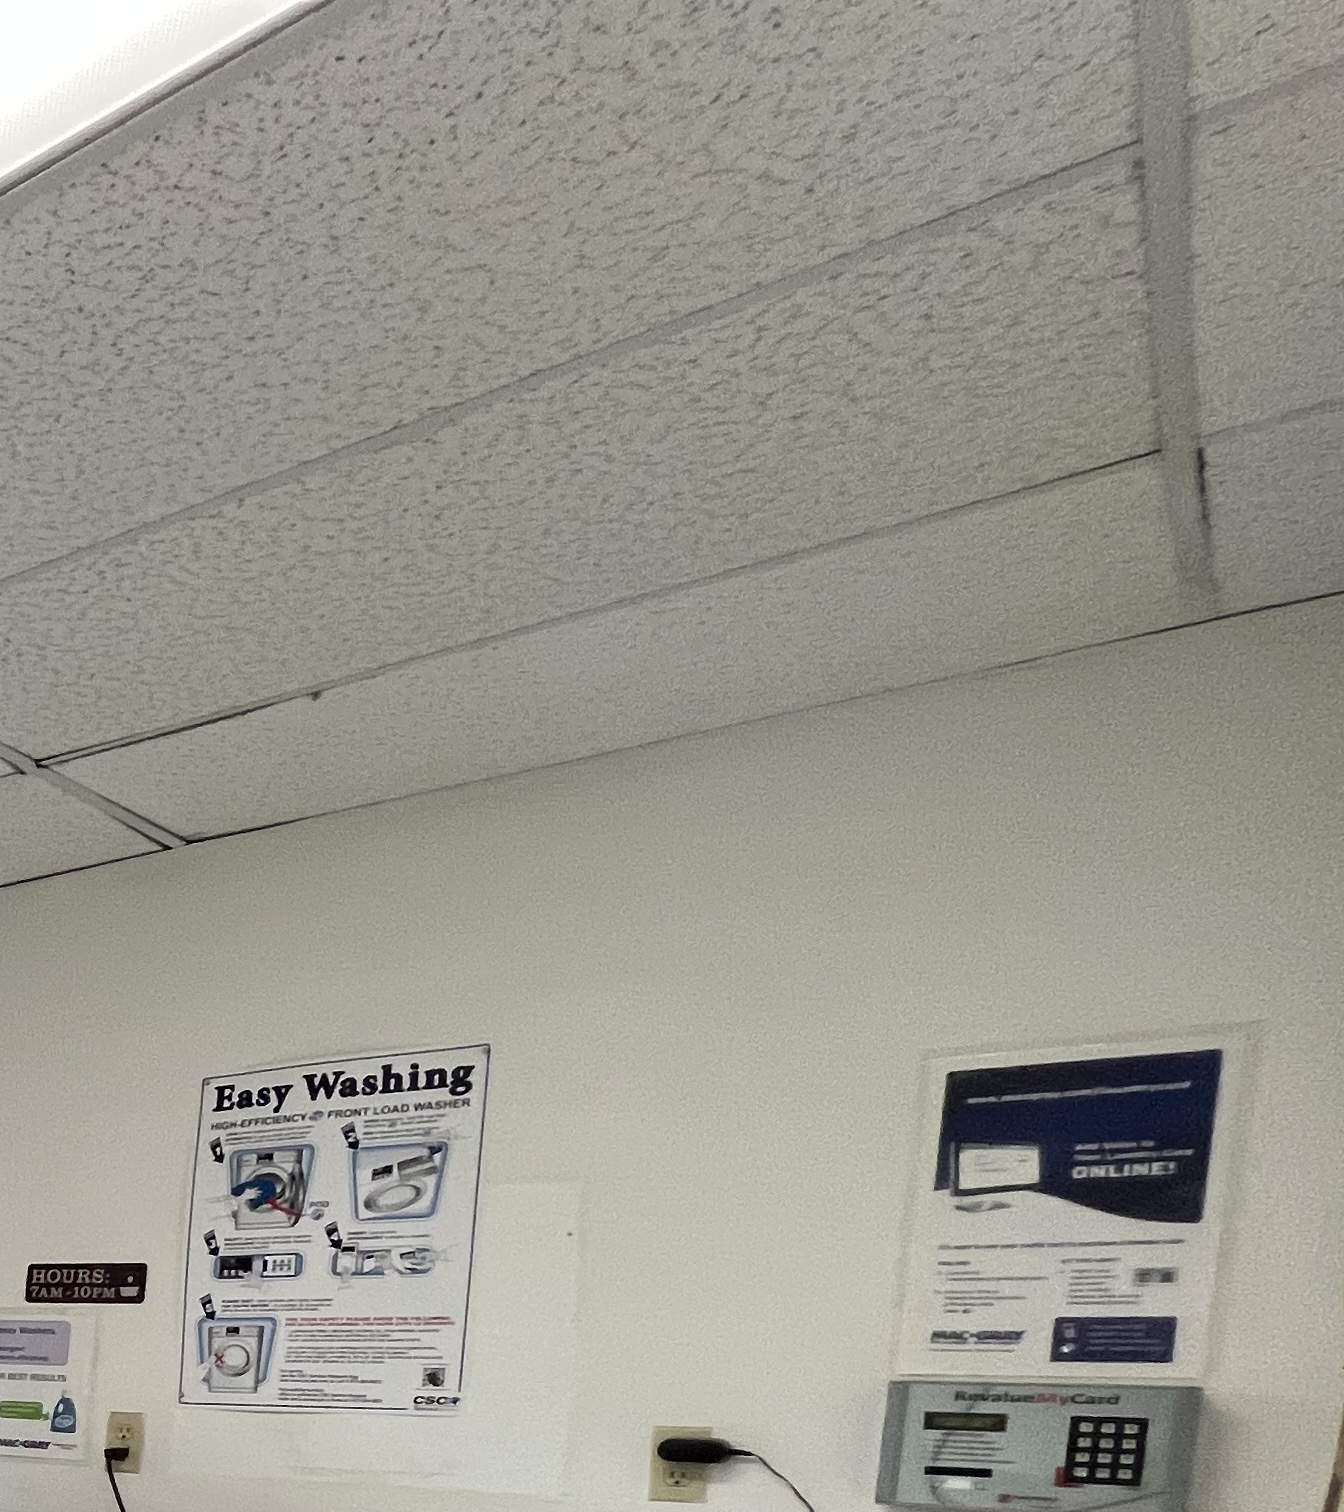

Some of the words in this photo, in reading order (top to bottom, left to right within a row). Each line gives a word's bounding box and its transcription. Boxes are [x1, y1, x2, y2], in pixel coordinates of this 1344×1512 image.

[212, 1084, 294, 1113] Easy
[303, 1063, 475, 1097] Washing
[210, 1112, 309, 1130] HIGH-EFFICIENCY
[327, 1107, 369, 1119] FRONT
[372, 1103, 410, 1116] LOAD
[413, 1098, 471, 1112] WASHER
[1072, 1161, 1176, 1179] ONLINE!
[31, 1268, 110, 1284] HOURS:
